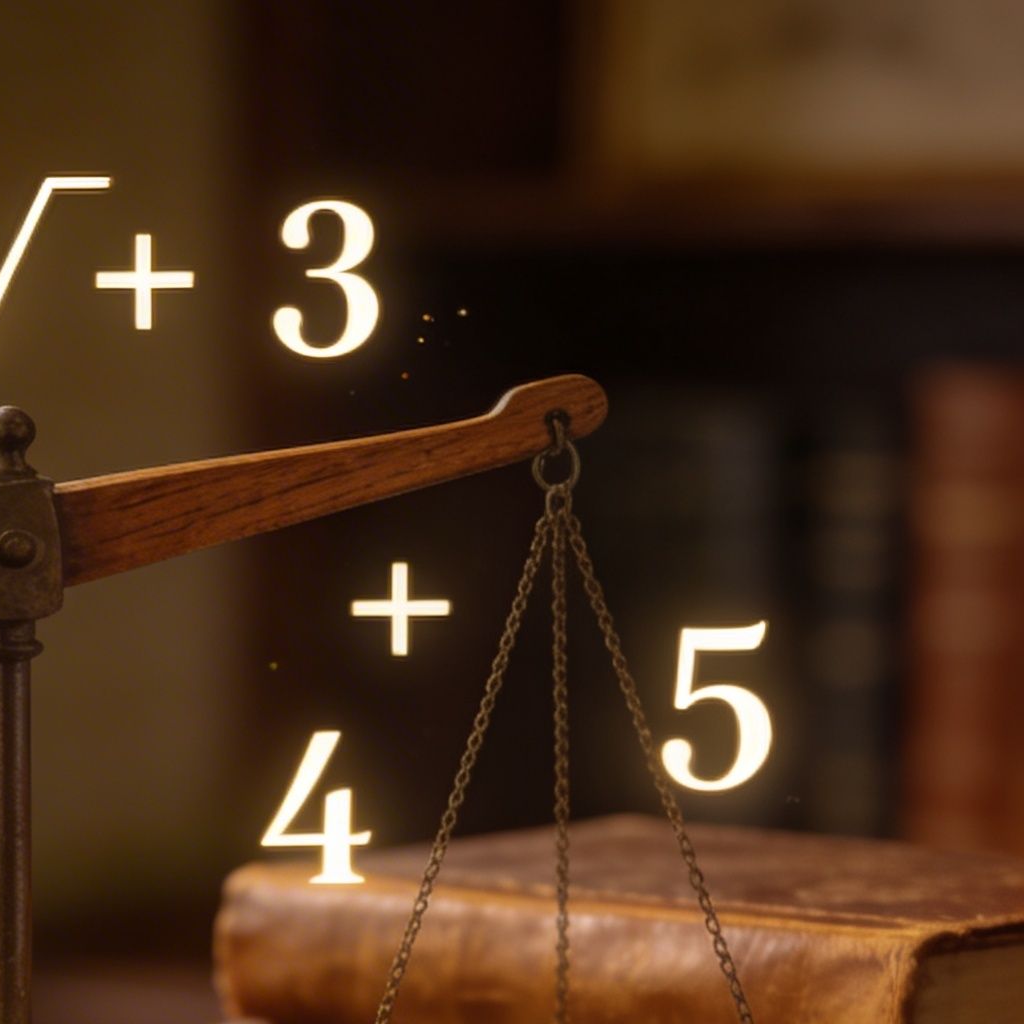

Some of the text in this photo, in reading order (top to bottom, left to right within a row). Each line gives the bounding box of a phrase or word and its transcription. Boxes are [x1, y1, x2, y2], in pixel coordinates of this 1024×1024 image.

[273, 200, 379, 358] 3
[662, 621, 775, 792] 5
[261, 731, 372, 885] 4
